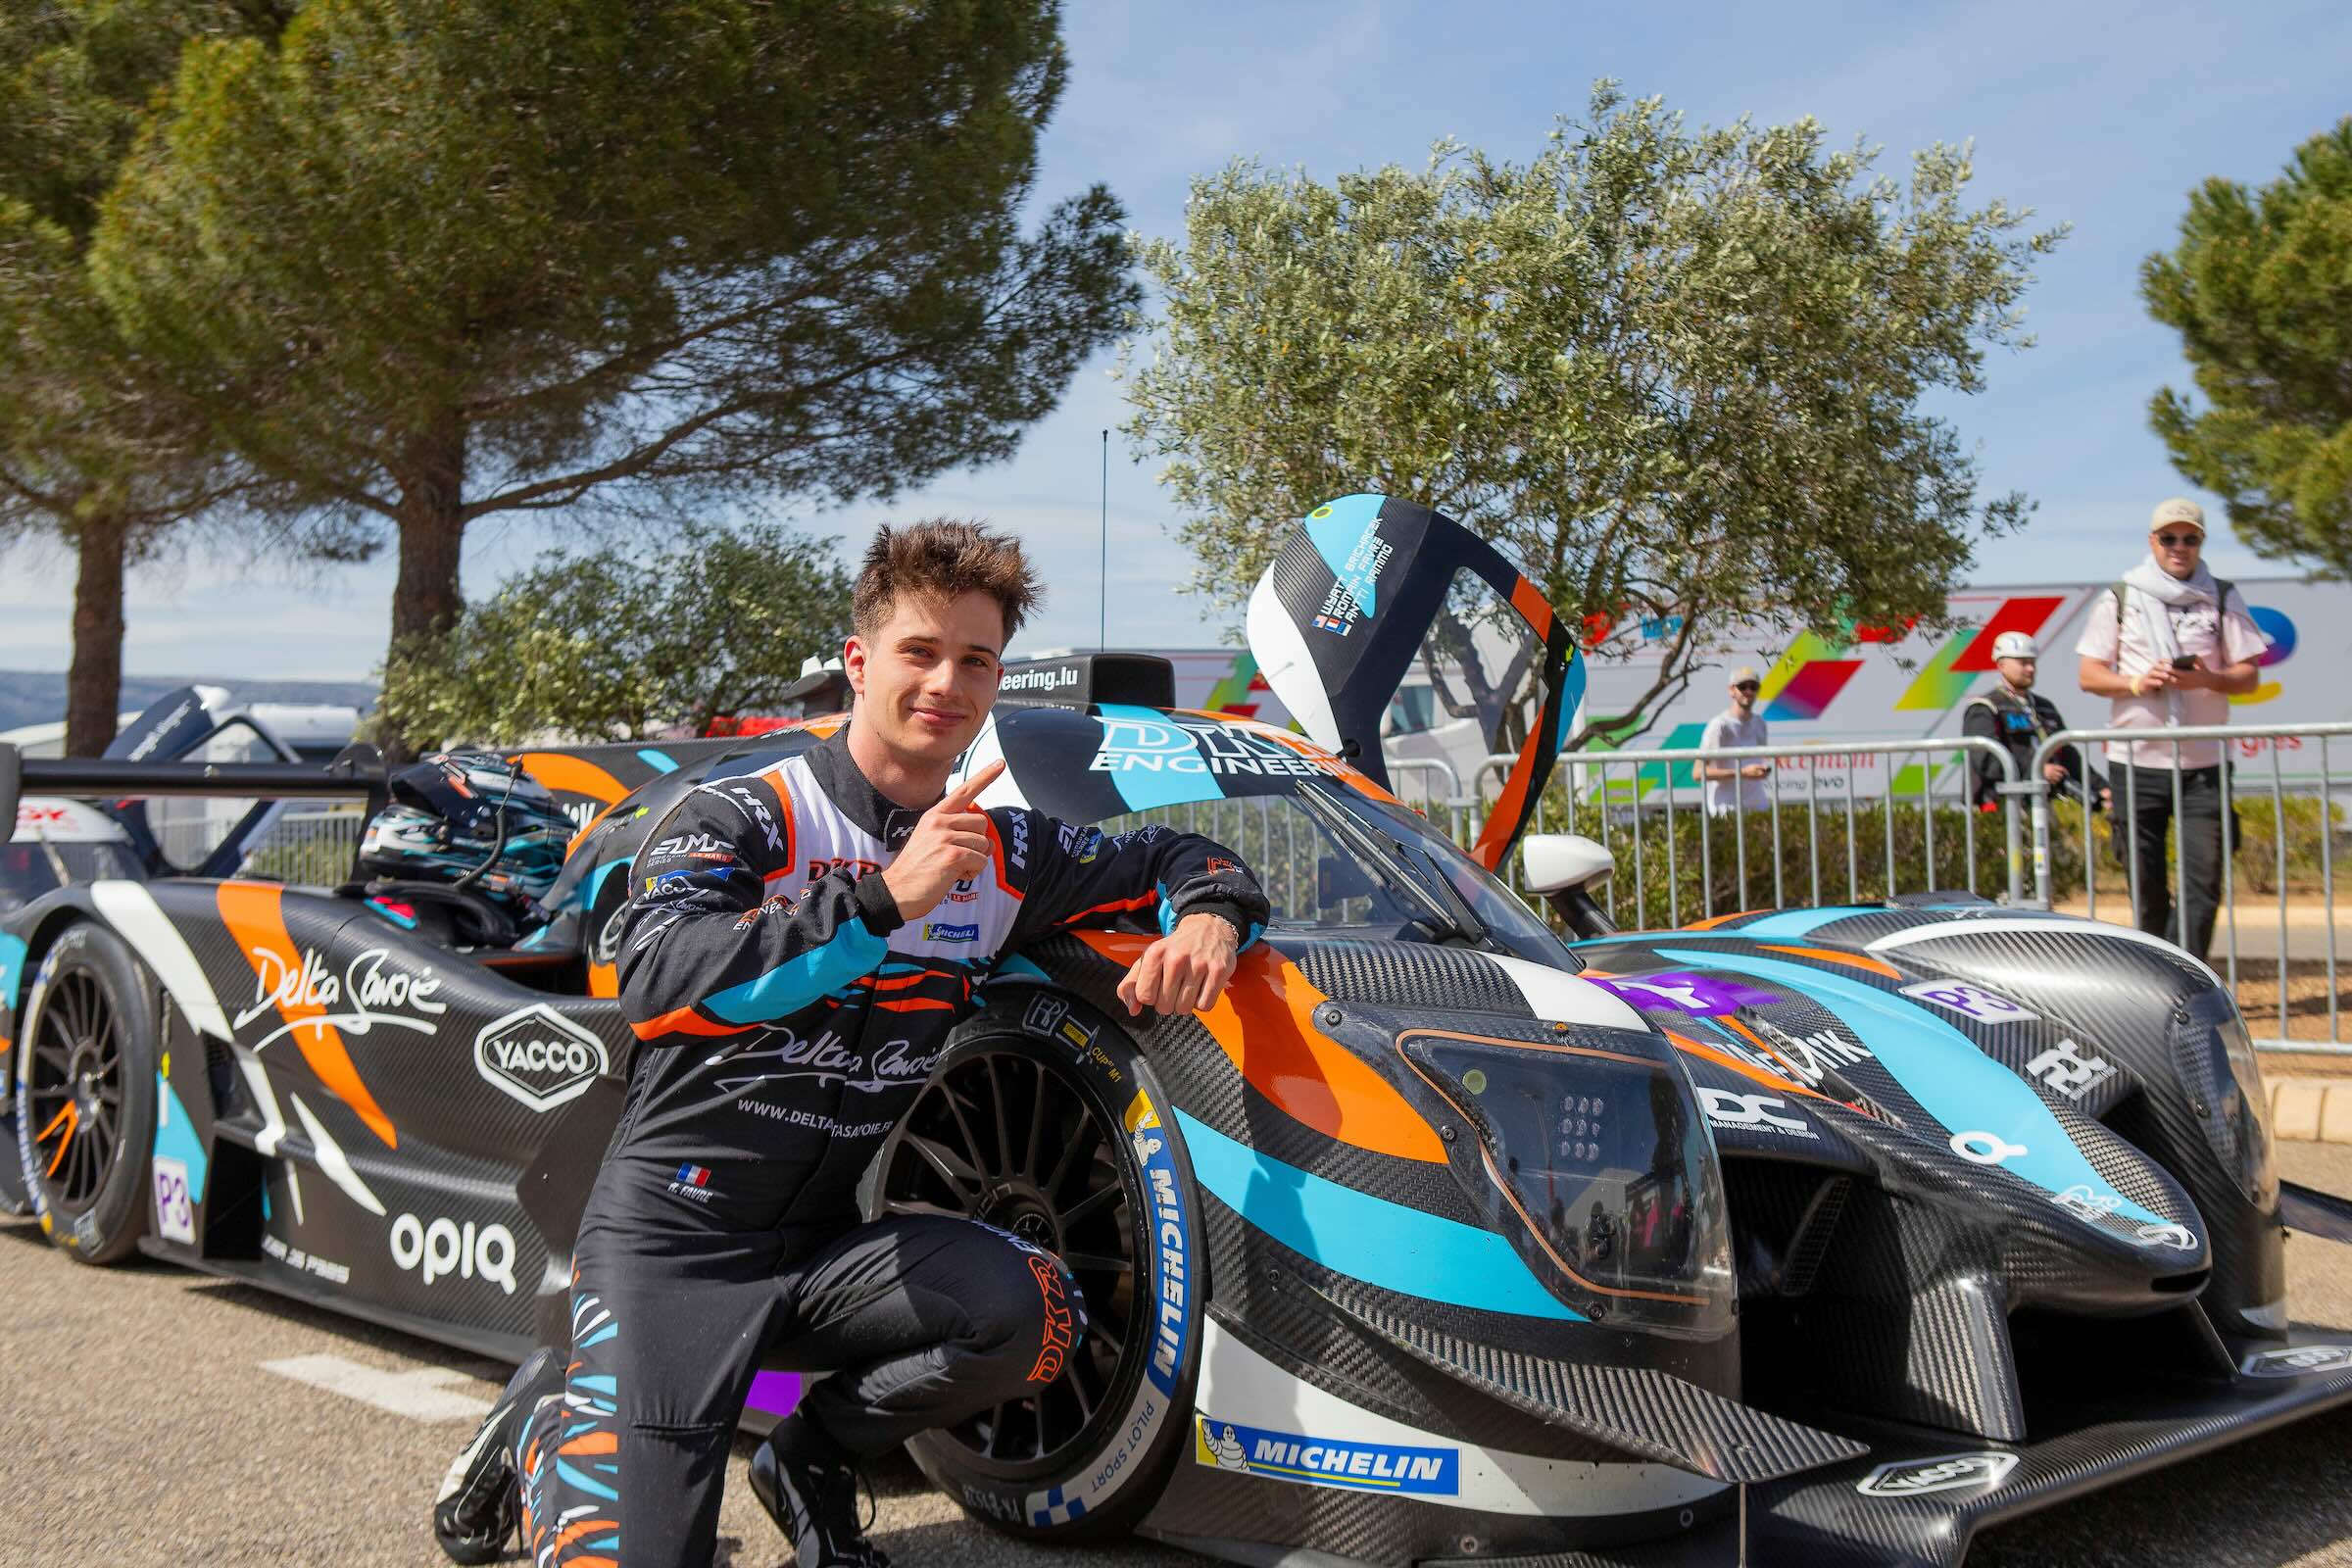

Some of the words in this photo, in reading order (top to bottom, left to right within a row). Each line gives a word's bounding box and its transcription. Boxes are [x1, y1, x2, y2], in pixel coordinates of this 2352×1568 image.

[1320, 574, 1348, 615] WYATT
[1333, 574, 1362, 619] ROMAIN
[1357, 535, 1385, 572] FAVRE
[1344, 587, 1369, 623] ANTTI
[1364, 543, 1394, 586] RAMMO
[730, 787, 783, 851] HRX
[233, 947, 339, 1030] Delta
[345, 948, 447, 1035] Savoie
[1924, 987, 2019, 1017] P3
[493, 1039, 589, 1075] YACCO
[160, 1173, 189, 1229] P3
[1150, 1168, 1184, 1379] MICHELIN
[1026, 1256, 1071, 1383] DKR
[1127, 1399, 1154, 1453] PILOT
[1092, 1448, 1129, 1494] SPORT
[1253, 1438, 1444, 1482] MICHELIN
